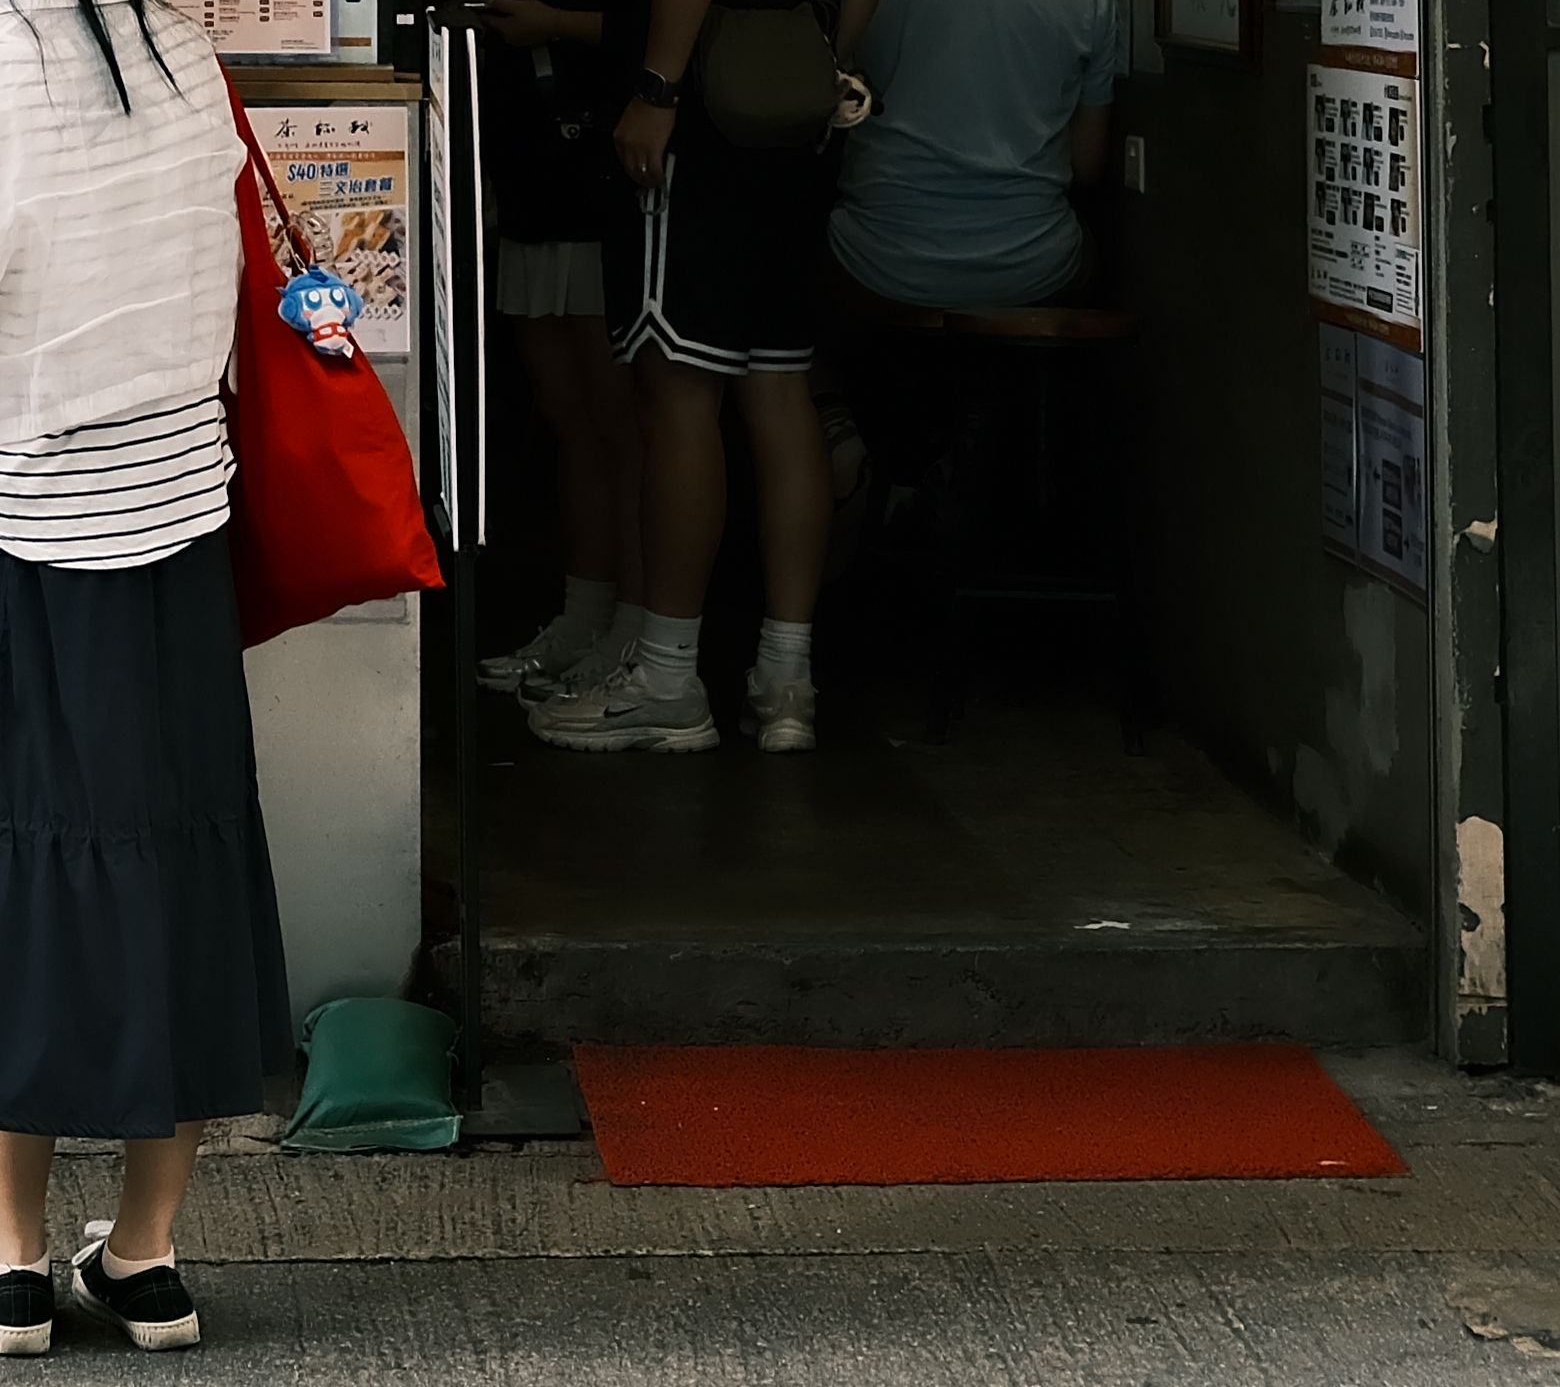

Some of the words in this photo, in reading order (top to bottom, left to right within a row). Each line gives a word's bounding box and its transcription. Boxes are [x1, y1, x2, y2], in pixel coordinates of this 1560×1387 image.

[287, 163, 317, 182] $40
[319, 177, 394, 197] 三文治套餐
